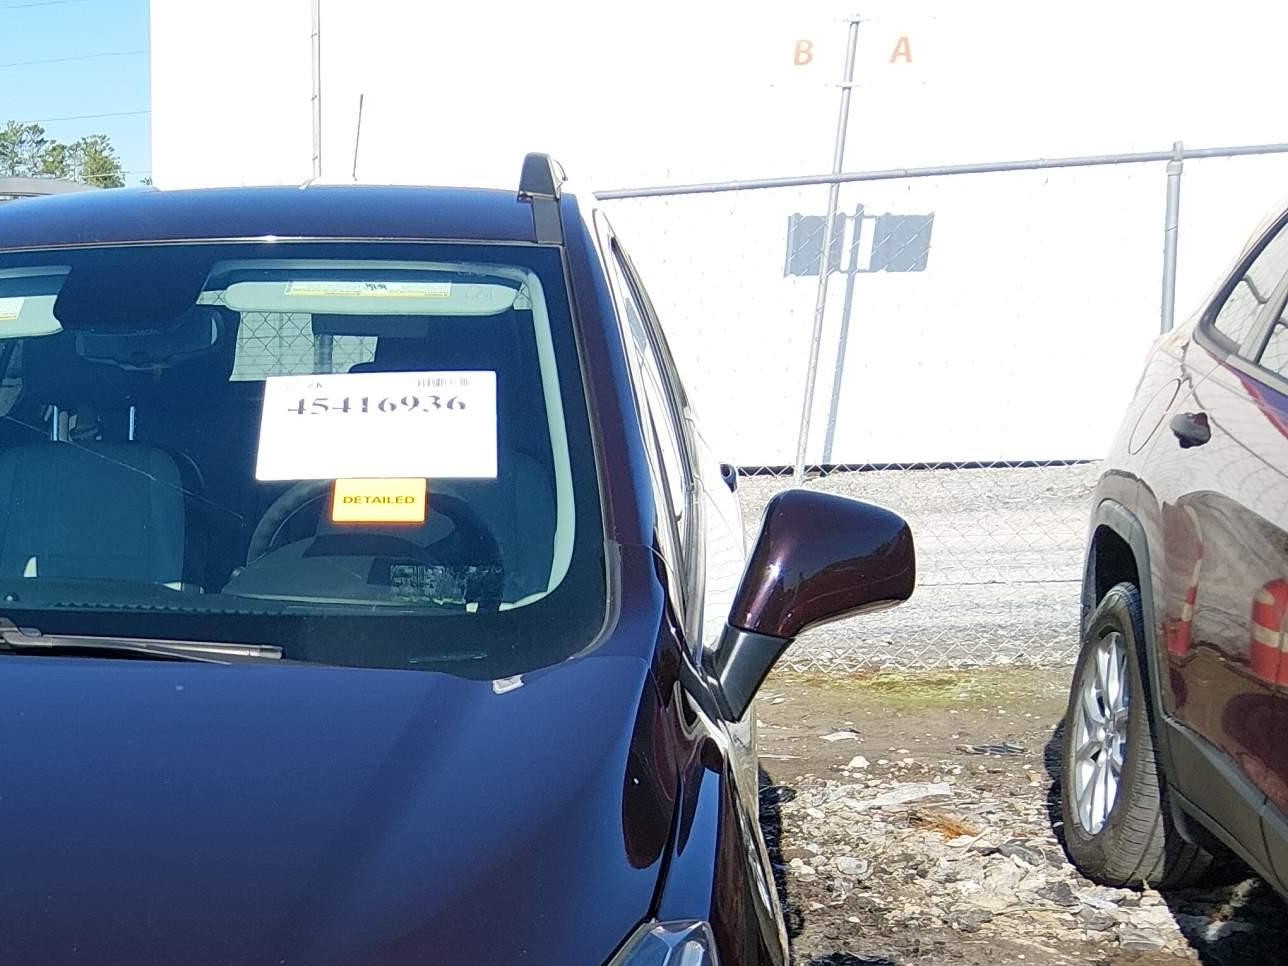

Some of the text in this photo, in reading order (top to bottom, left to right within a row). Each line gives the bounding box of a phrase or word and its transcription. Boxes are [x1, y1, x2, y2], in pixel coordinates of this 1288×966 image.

[793, 39, 814, 66] B
[888, 36, 913, 64] A
[287, 396, 467, 415] 45416936
[342, 495, 415, 505] DETAILED
